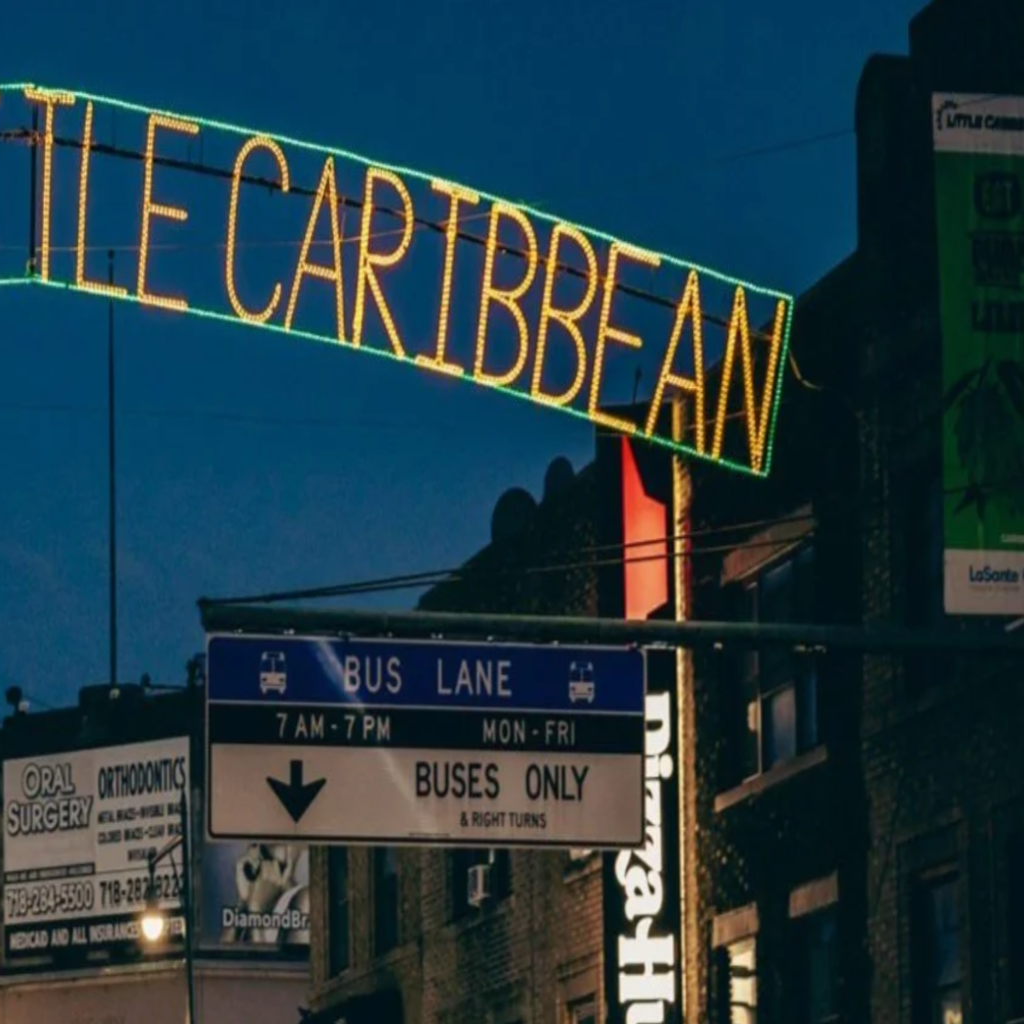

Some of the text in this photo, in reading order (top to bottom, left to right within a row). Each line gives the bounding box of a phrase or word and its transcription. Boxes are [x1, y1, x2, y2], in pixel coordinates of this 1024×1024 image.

[226, 134, 787, 474] CARIBBEAN
[343, 655, 512, 697] BUS LANE
[22, 762, 76, 800] ORAL
[97, 756, 186, 800] ORTHODONTICS
[415, 761, 589, 801] BUSES ONLY
[6, 795, 94, 838] SURGERY
[459, 811, 547, 829] & RIGHT TURNS
[6, 880, 95, 919] 718-284-5500
[222, 907, 312, 930] DiamondBr
[51, 928, 70, 946] AND
[72, 925, 88, 945] ALL
